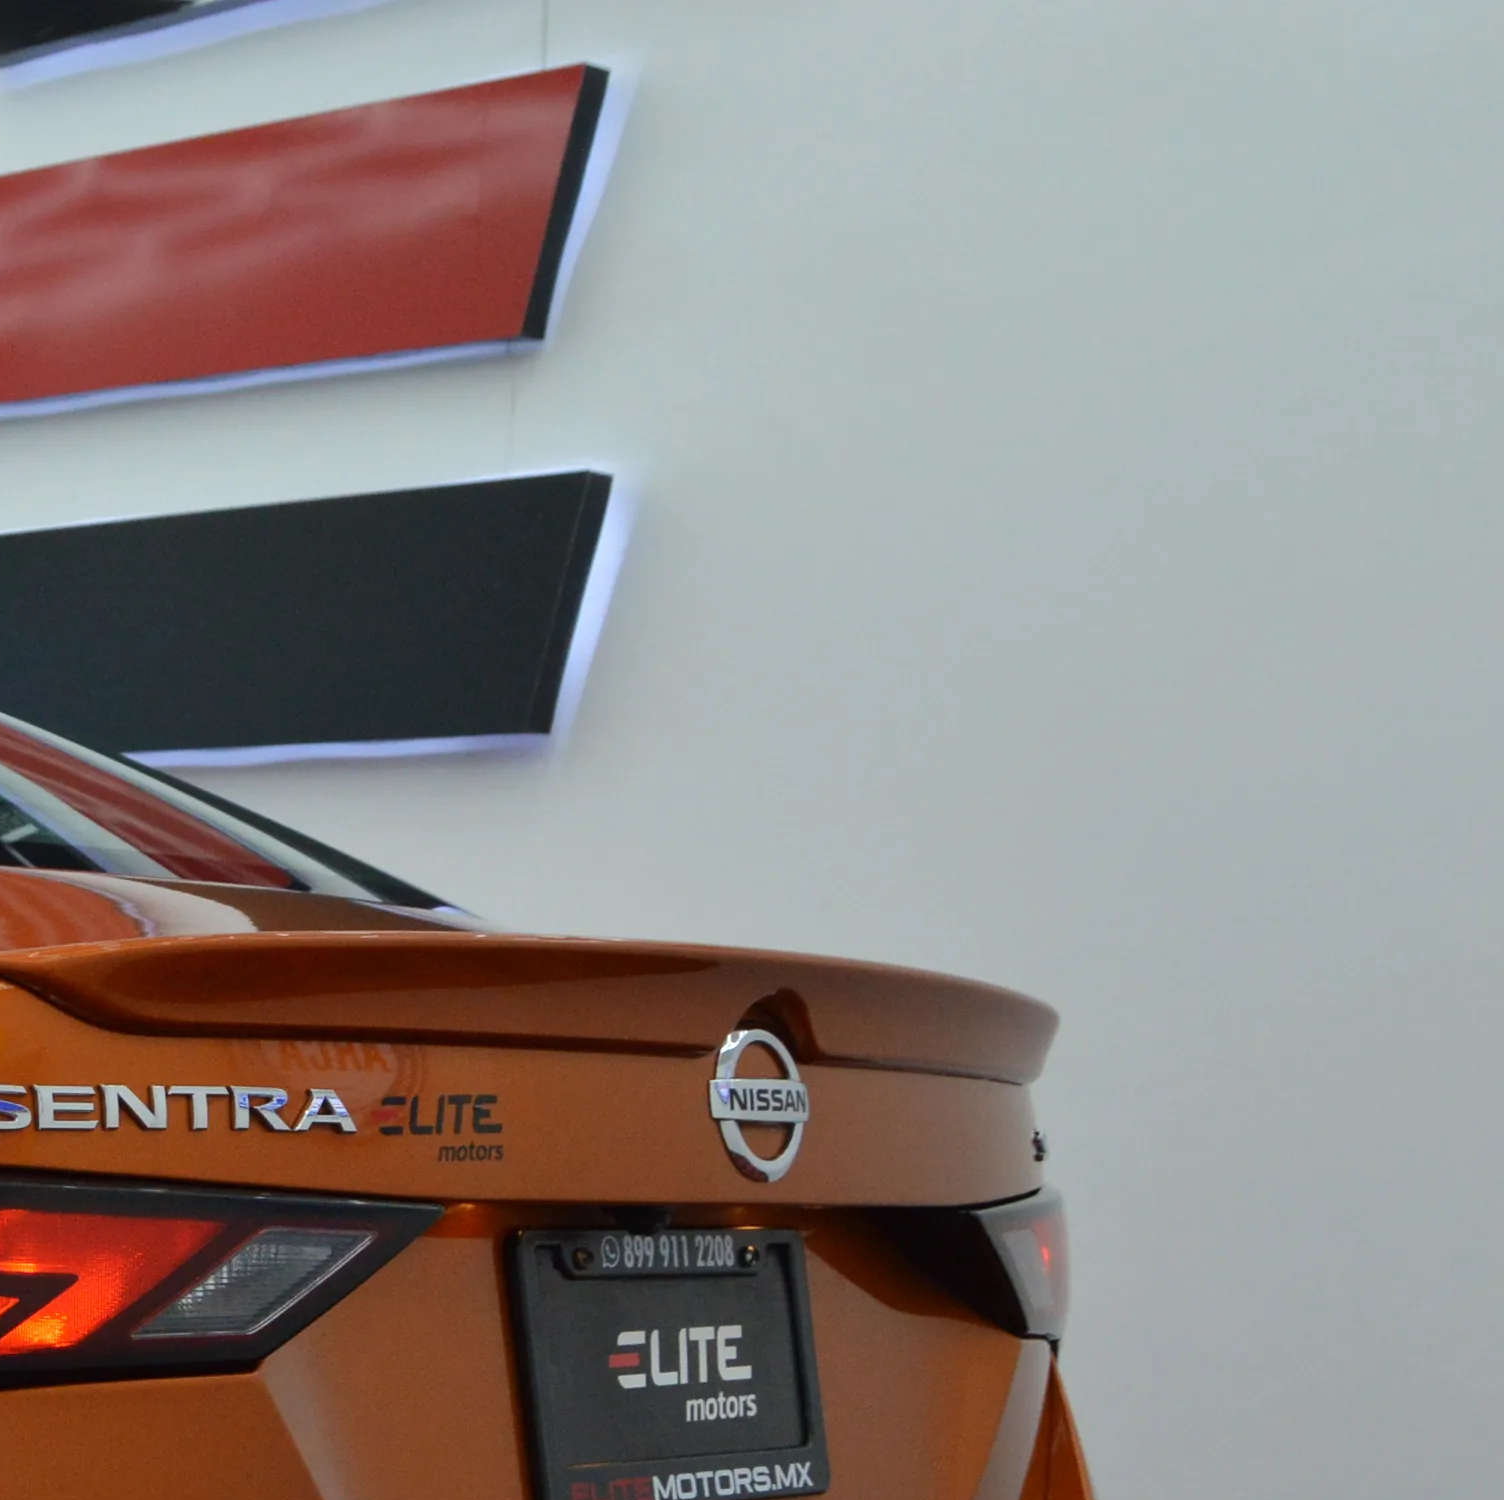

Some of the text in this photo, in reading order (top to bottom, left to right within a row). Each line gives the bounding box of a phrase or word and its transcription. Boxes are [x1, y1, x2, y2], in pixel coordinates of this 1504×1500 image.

[373, 1094, 503, 1136] ELITE
[728, 1088, 807, 1114] NISSAN
[438, 1140, 504, 1163] motors
[622, 1234, 735, 1268] 899 911 2208
[608, 1324, 753, 1389] ELITE
[686, 1391, 758, 1422] motors
